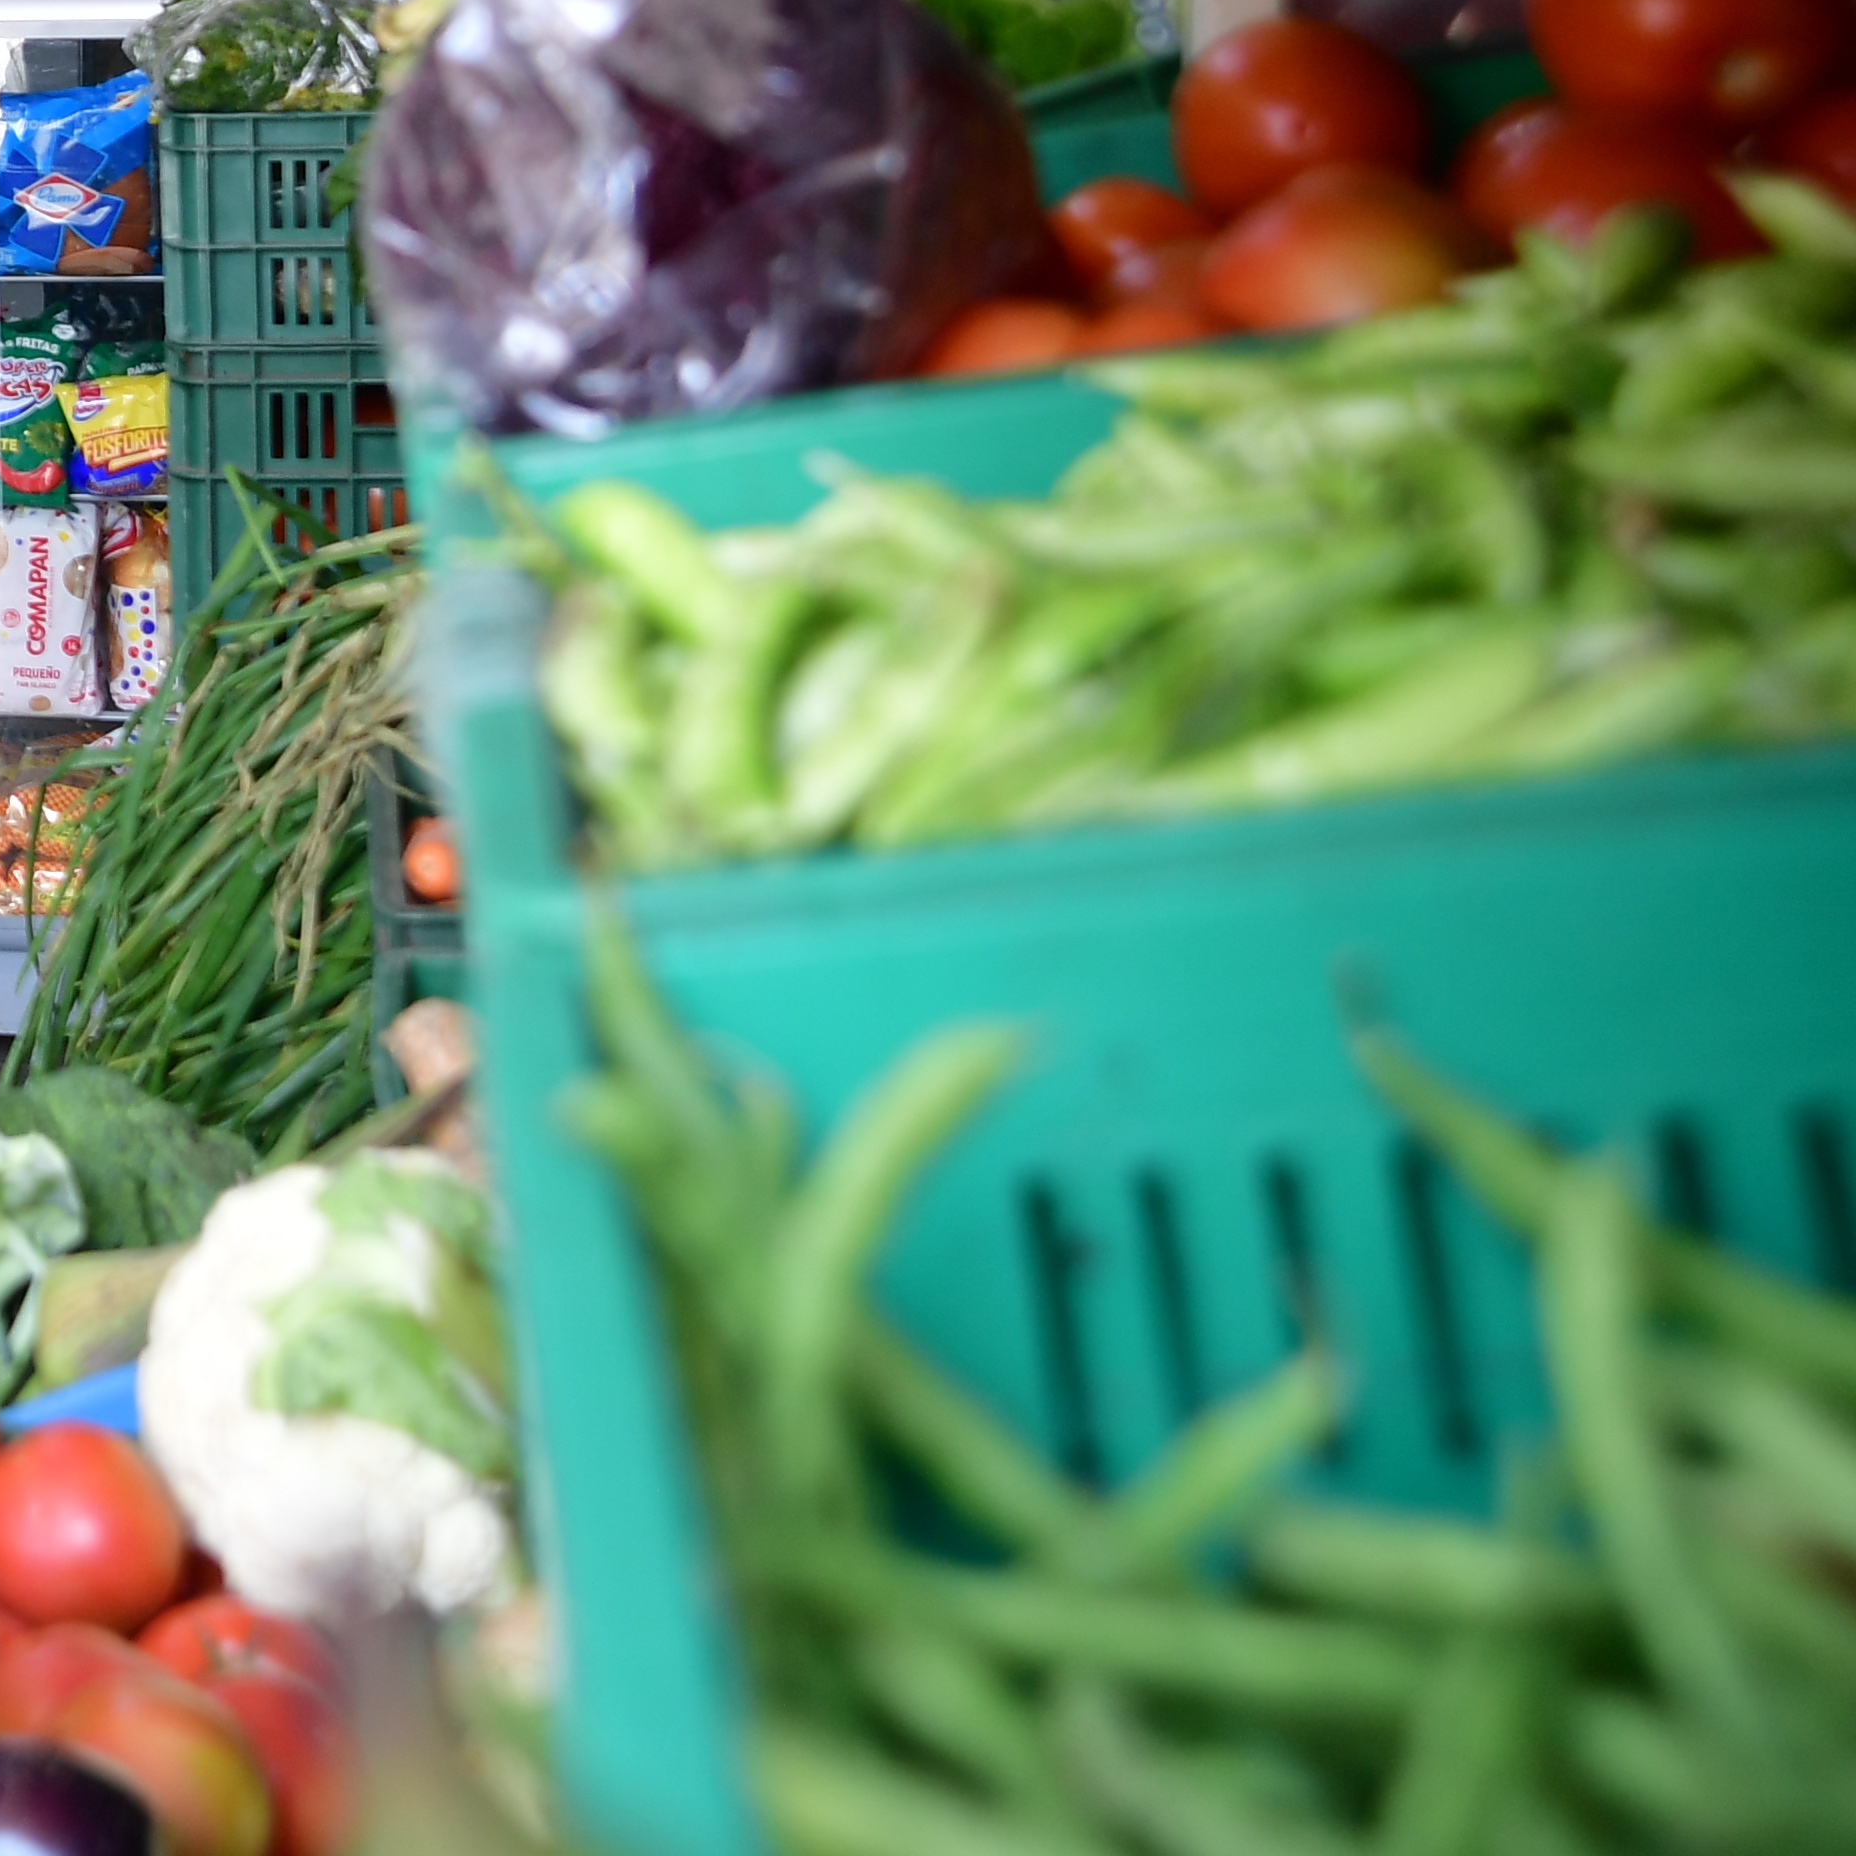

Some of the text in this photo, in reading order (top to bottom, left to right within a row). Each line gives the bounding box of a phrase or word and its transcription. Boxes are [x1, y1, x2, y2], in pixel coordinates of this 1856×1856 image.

[15, 336, 61, 355] FRITAS
[25, 535, 50, 656] COMAPAN
[12, 665, 61, 682] PEQUEÑO
